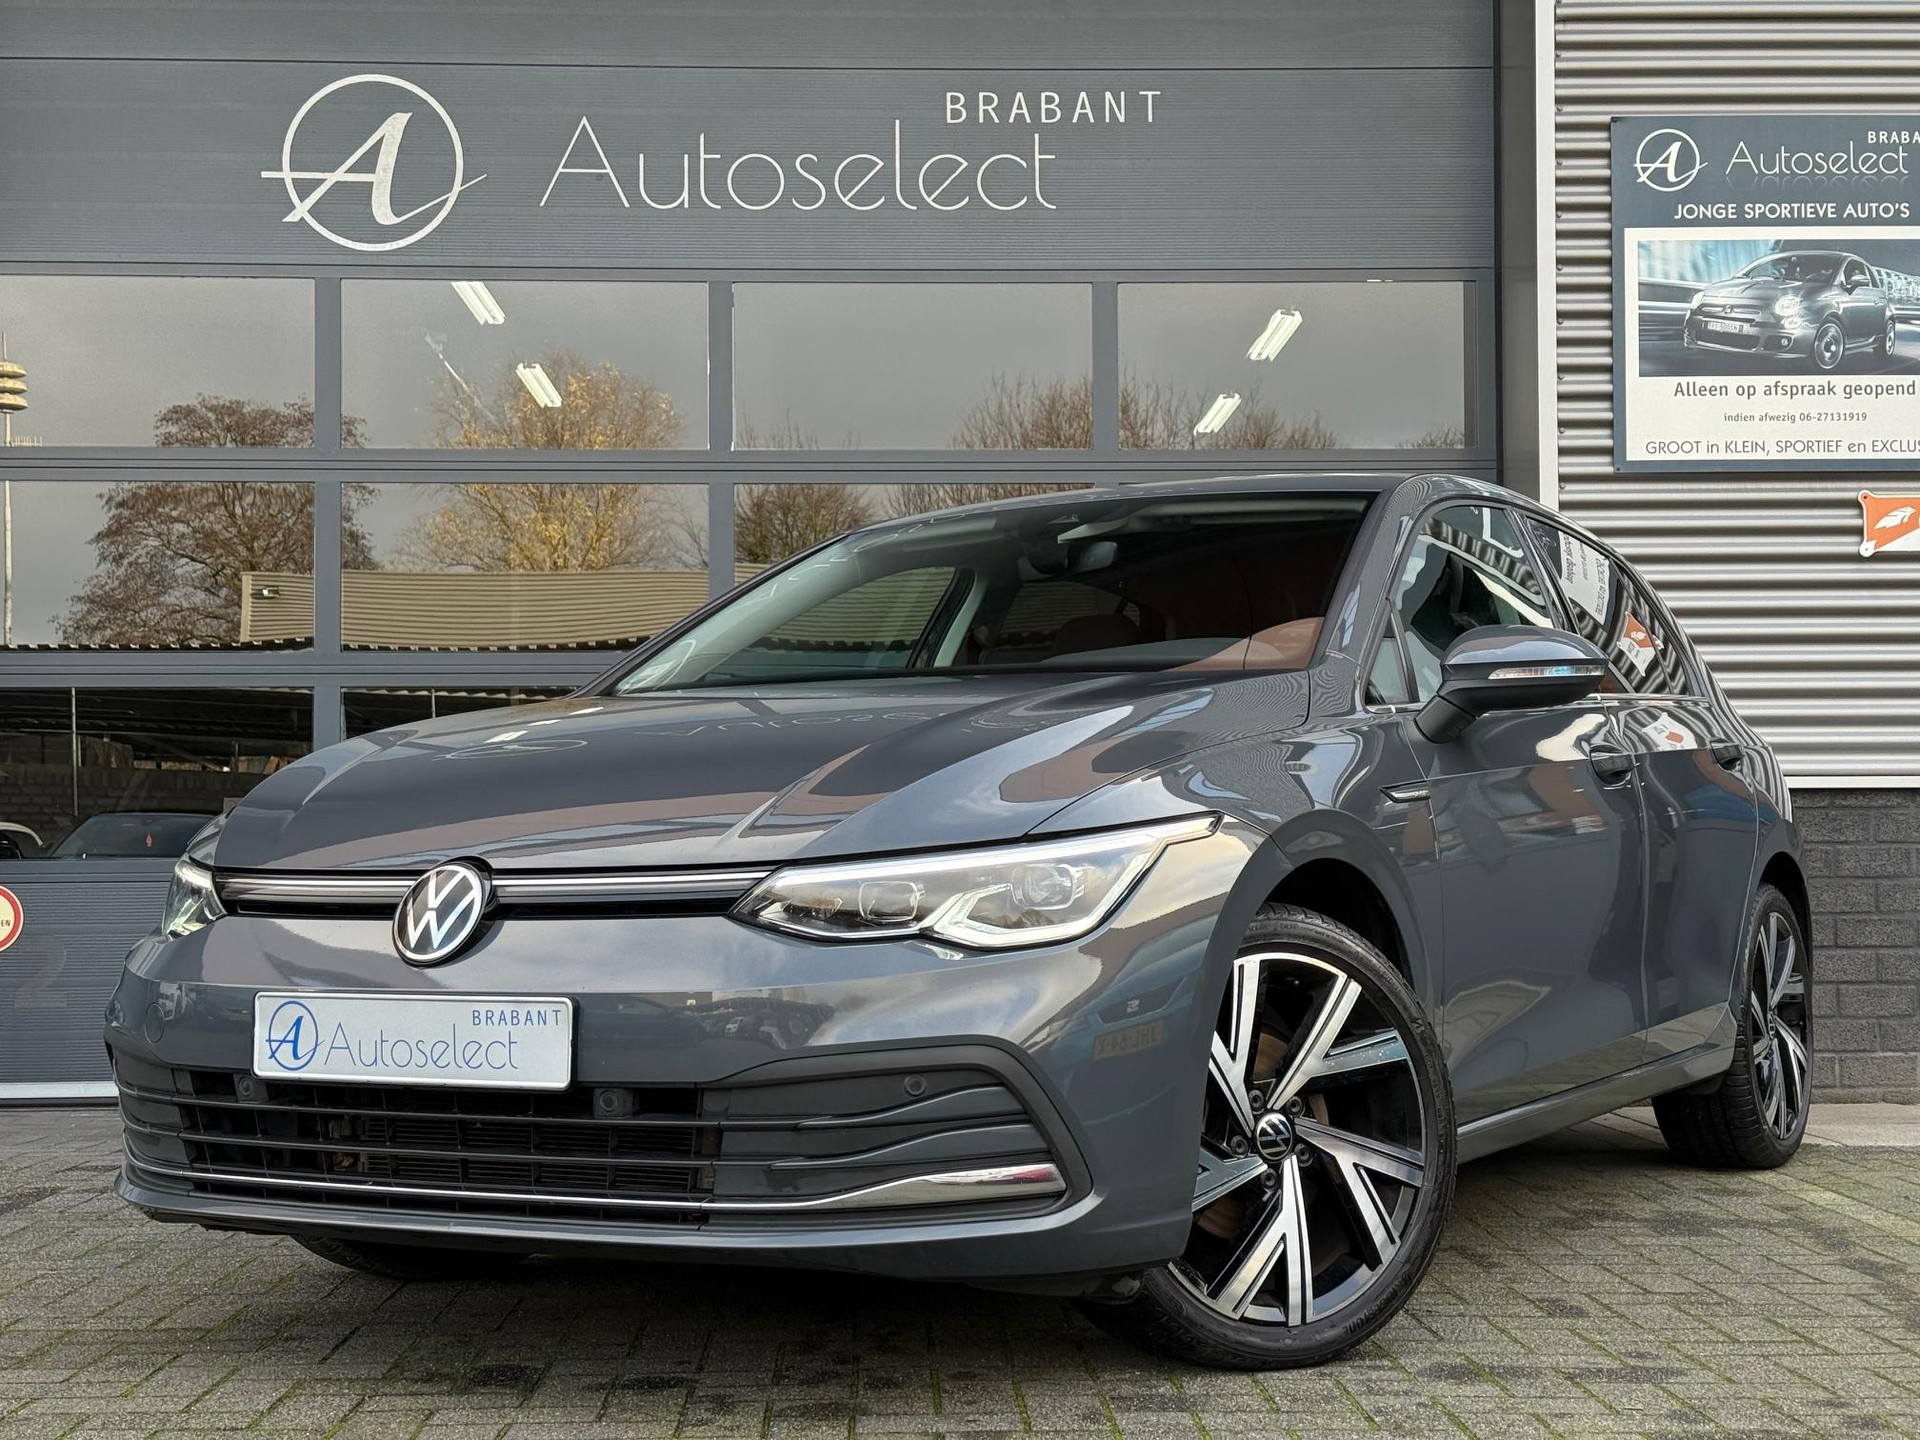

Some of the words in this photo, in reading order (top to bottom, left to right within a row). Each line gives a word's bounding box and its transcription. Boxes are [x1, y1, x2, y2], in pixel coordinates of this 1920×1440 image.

[945, 90, 1161, 124] BRABANT
[539, 115, 1057, 211] Autoselect
[1725, 140, 1909, 175] Autoselect
[1674, 203, 1738, 219] JONGE
[1744, 202, 1837, 219] SPORTIEVE
[1843, 202, 1911, 219] AUTO'S
[1673, 381, 1729, 397] Alleen
[1736, 383, 1757, 400] op
[1763, 381, 1836, 400] afspraak
[1843, 380, 1917, 400] geopend
[1724, 412, 1755, 422] indien
[1758, 412, 1796, 424] afwezig
[1799, 412, 1868, 422] 06-27131919
[1645, 441, 1701, 454] GROOT
[1706, 441, 1719, 453] in
[1724, 440, 1771, 456] KLEIN,
[1776, 440, 1843, 453] SPORTIEF
[1850, 442, 1867, 453] en
[471, 1009, 561, 1026] BRABANT
[324, 1021, 519, 1070] Autoselect
